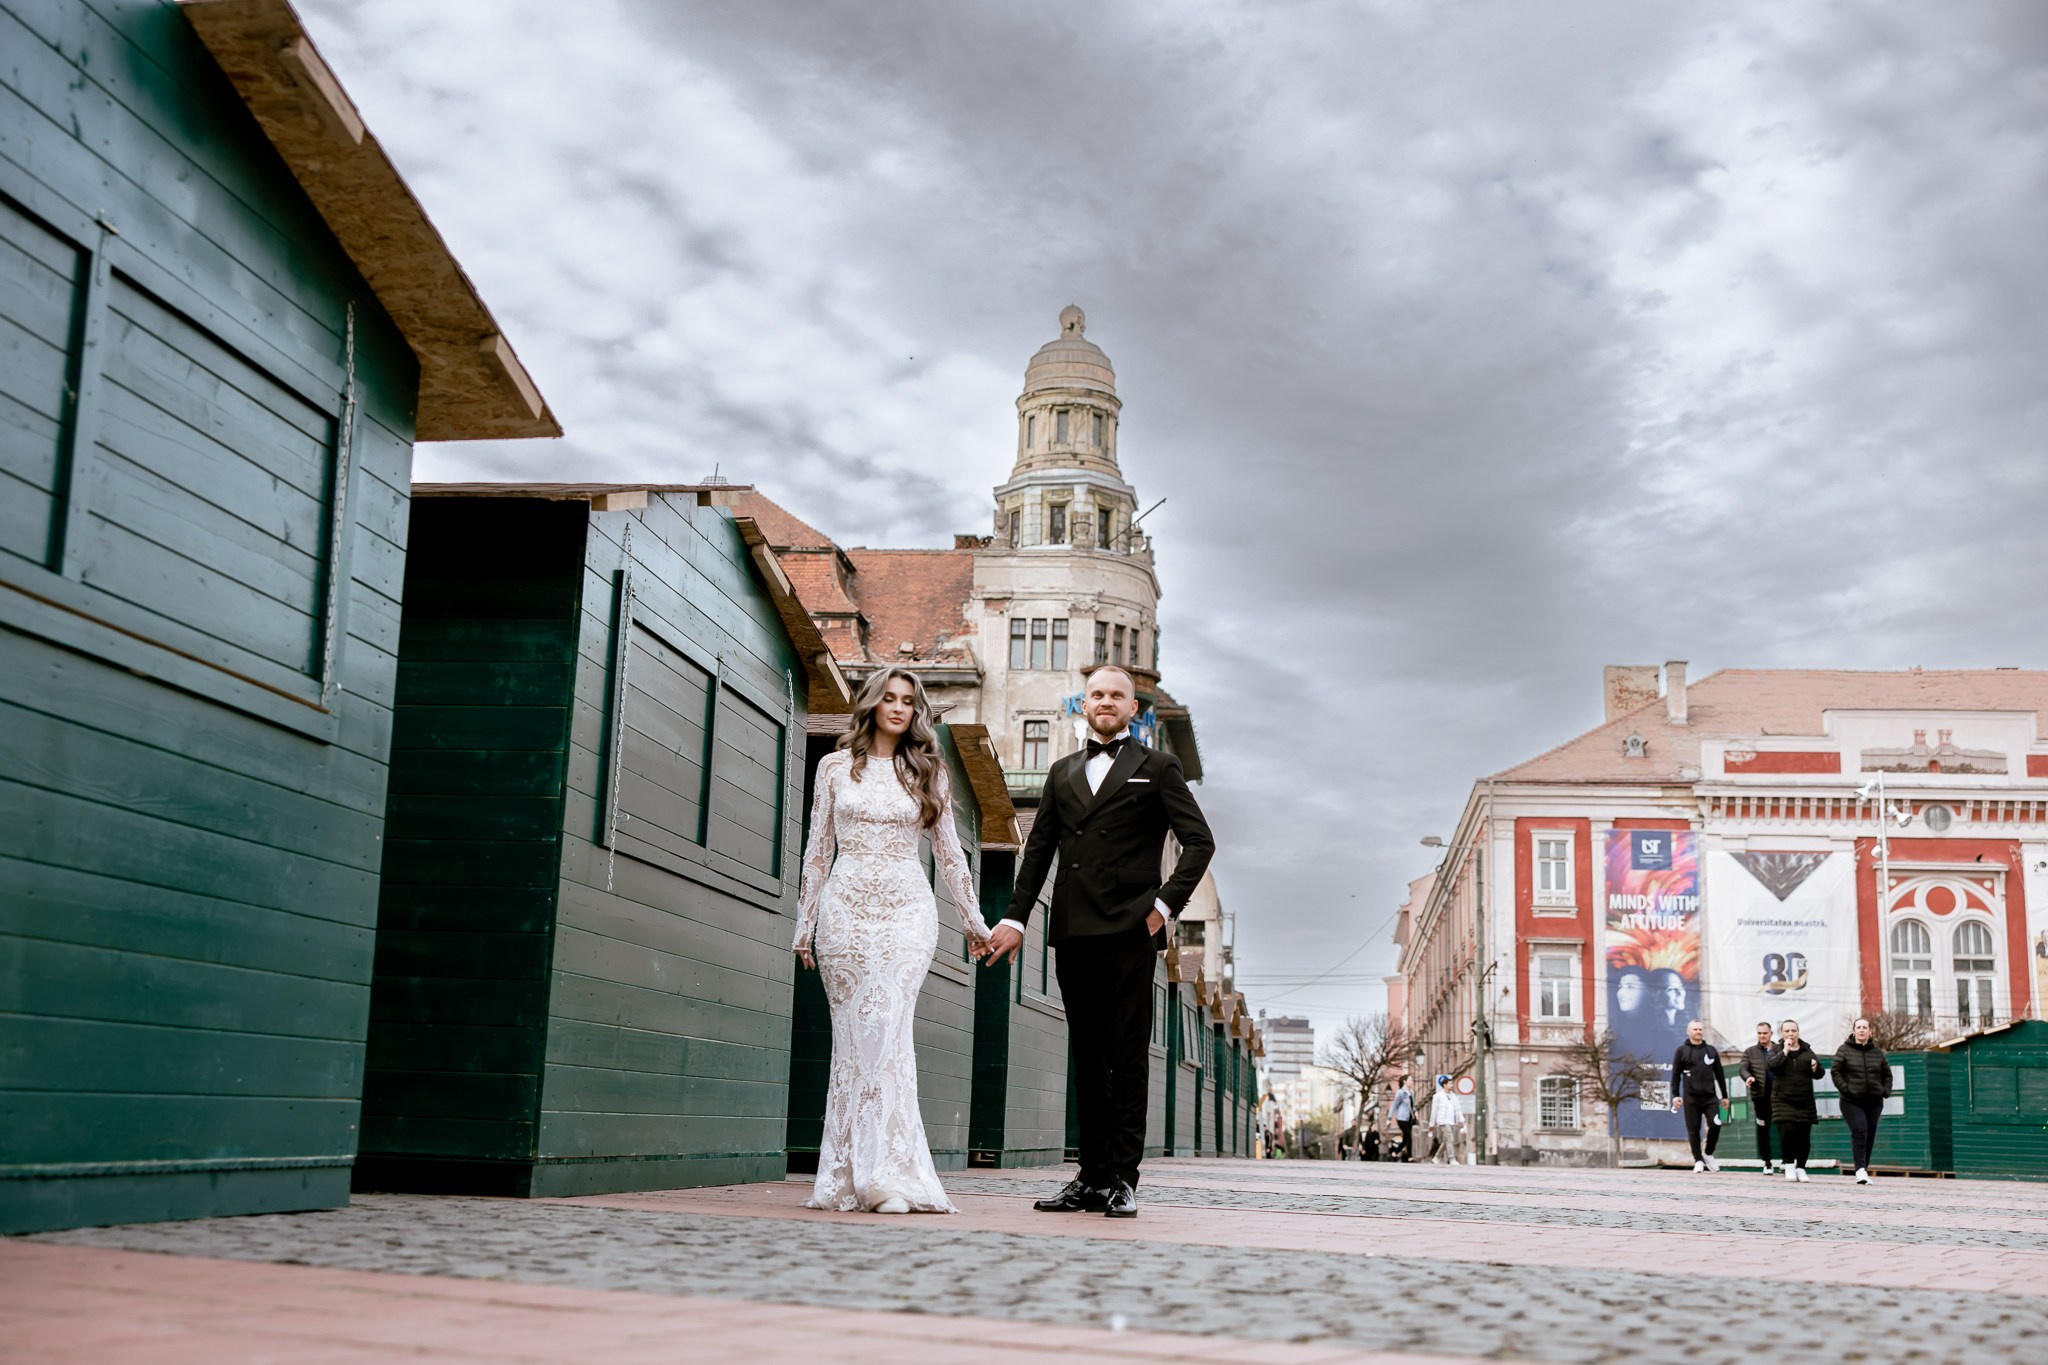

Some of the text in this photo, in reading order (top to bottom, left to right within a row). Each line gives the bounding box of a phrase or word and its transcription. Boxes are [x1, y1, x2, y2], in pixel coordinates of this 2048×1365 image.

[1609, 893, 1696, 911] MINDS WITH
[1620, 914, 1685, 930] ATTITUDE
[1737, 918, 1792, 927] Universitatea
